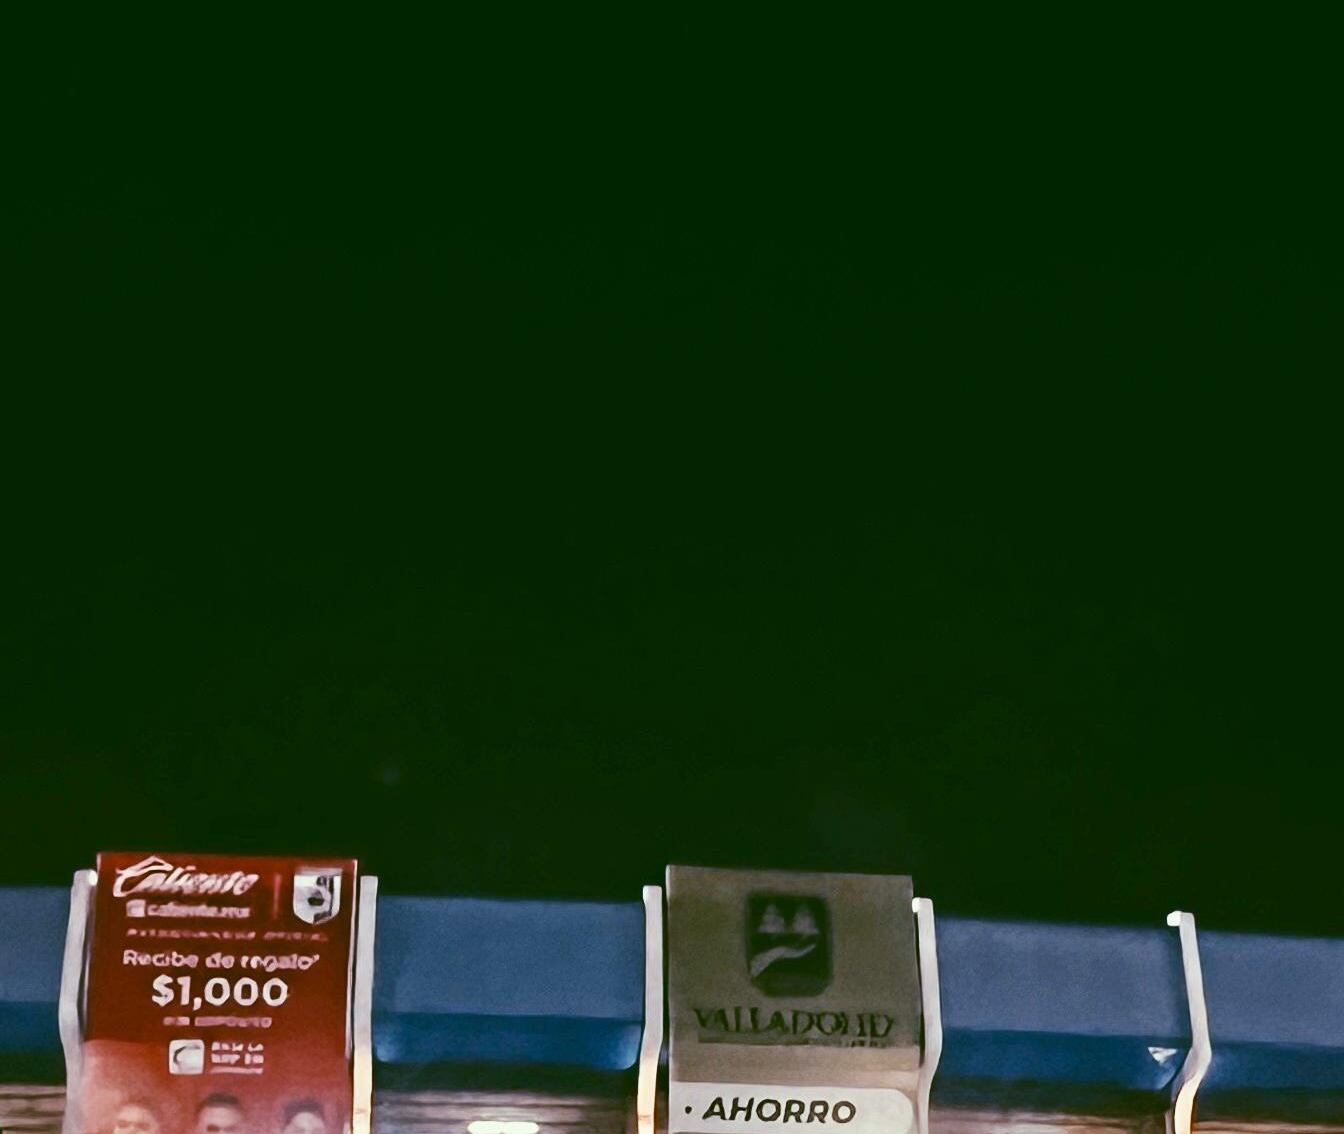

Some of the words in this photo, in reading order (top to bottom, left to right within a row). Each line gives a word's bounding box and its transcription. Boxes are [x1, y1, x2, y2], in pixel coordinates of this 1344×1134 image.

[112, 856, 259, 898] Caliente
[123, 950, 199, 969] Recibe
[205, 952, 235, 969] de
[152, 974, 289, 1011] $1,000
[692, 1006, 895, 1038] VALLADOLID
[701, 1096, 857, 1124] AHORRO
